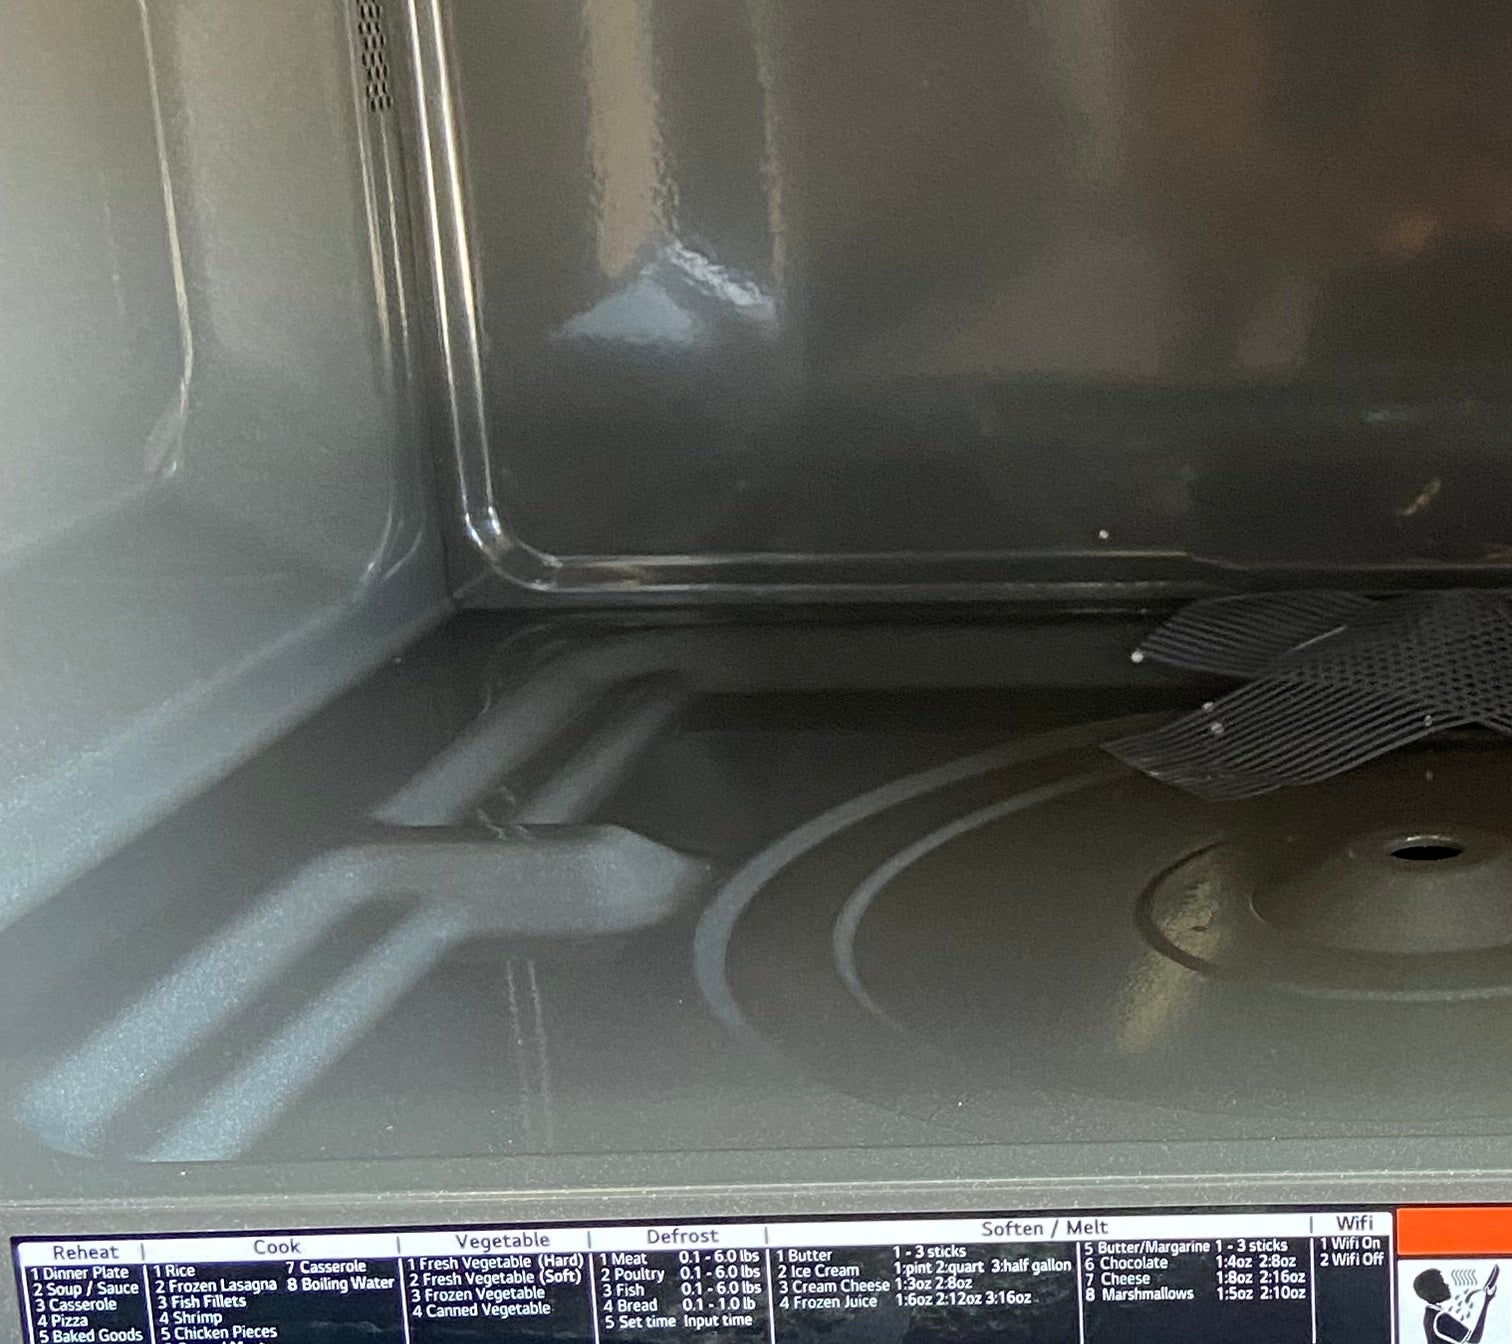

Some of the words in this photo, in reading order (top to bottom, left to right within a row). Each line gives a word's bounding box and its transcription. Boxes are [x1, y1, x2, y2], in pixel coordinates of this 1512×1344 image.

[981, 1220, 1043, 1237] Soften
[1066, 1220, 1109, 1235] Melt
[1336, 1216, 1373, 1231] Wifi
[455, 1233, 550, 1253] Vegetable
[647, 1229, 719, 1245] Defrost
[1321, 1237, 1326, 1249] 1
[1332, 1236, 1360, 1249] Wifi
[1363, 1238, 1380, 1249] On
[53, 1245, 119, 1260] Reheat
[254, 1240, 300, 1255] Cook
[1084, 1244, 1093, 1256] 5
[1098, 1241, 1210, 1256] Butter/Margarine
[1237, 1241, 1245, 1252] 3
[1249, 1239, 1288, 1252] sticks
[409, 1258, 415, 1270] 1
[420, 1257, 458, 1270] Fresh
[462, 1256, 532, 1272] Vegetable
[538, 1254, 584, 1268] (Hard)
[1085, 1258, 1094, 1270] 6
[1100, 1257, 1168, 1269] Chocolate
[1217, 1256, 1252, 1268] 1:4oz
[1259, 1256, 1296, 1268] 2:8oz
[1320, 1253, 1329, 1266] 2
[1332, 1253, 1361, 1266] Wifi
[1364, 1252, 1384, 1265] Off
[31, 1268, 38, 1280] 1
[43, 1267, 89, 1280] Dinner
[93, 1267, 129, 1279] Plate
[154, 1265, 161, 1277] 1
[165, 1264, 195, 1277] Rice
[285, 1262, 294, 1274] 7
[300, 1260, 366, 1273] Casserole
[156, 1281, 165, 1293] 2
[169, 1279, 217, 1293] Frozen
[220, 1278, 277, 1293] Lasagna
[287, 1279, 298, 1291] 8
[302, 1277, 348, 1293] Boiling
[351, 1276, 395, 1289] Water
[410, 1274, 419, 1286] 2
[423, 1272, 461, 1285] Fresh
[465, 1271, 534, 1287] Vegetable
[539, 1269, 581, 1285] (Soft)
[1086, 1274, 1093, 1285] 7
[1101, 1272, 1150, 1285] Cheese
[1217, 1272, 1253, 1284] 1:8oz
[1259, 1271, 1306, 1283] 2:16oz
[33, 1284, 43, 1296] 2
[47, 1283, 82, 1299] Soup
[98, 1282, 139, 1294] Sauce
[411, 1289, 421, 1302] 3
[425, 1288, 472, 1301] Frozen
[476, 1287, 545, 1302] Vegetable
[1085, 1289, 1095, 1301] 8
[1102, 1287, 1194, 1300] Marshmallows
[1217, 1287, 1253, 1300] 1:5oz
[1260, 1286, 1306, 1299] 2:10oz
[35, 1299, 45, 1312] 3
[49, 1297, 117, 1312] Casserole
[157, 1297, 167, 1309] 3
[172, 1295, 200, 1309] Fish
[204, 1295, 247, 1308] Fillets
[412, 1306, 423, 1318] 4
[427, 1304, 478, 1317] Canned
[482, 1302, 551, 1318] Vegetable
[37, 1315, 48, 1328] 4
[52, 1314, 88, 1328] Pizza
[159, 1312, 169, 1324] 4
[173, 1310, 222, 1326] Shrimp
[39, 1331, 49, 1343] 5
[53, 1330, 95, 1343] Baked
[99, 1328, 143, 1342] Goods
[161, 1328, 171, 1340] 5
[175, 1326, 229, 1340] Chicken
[233, 1326, 278, 1339] Pieces
